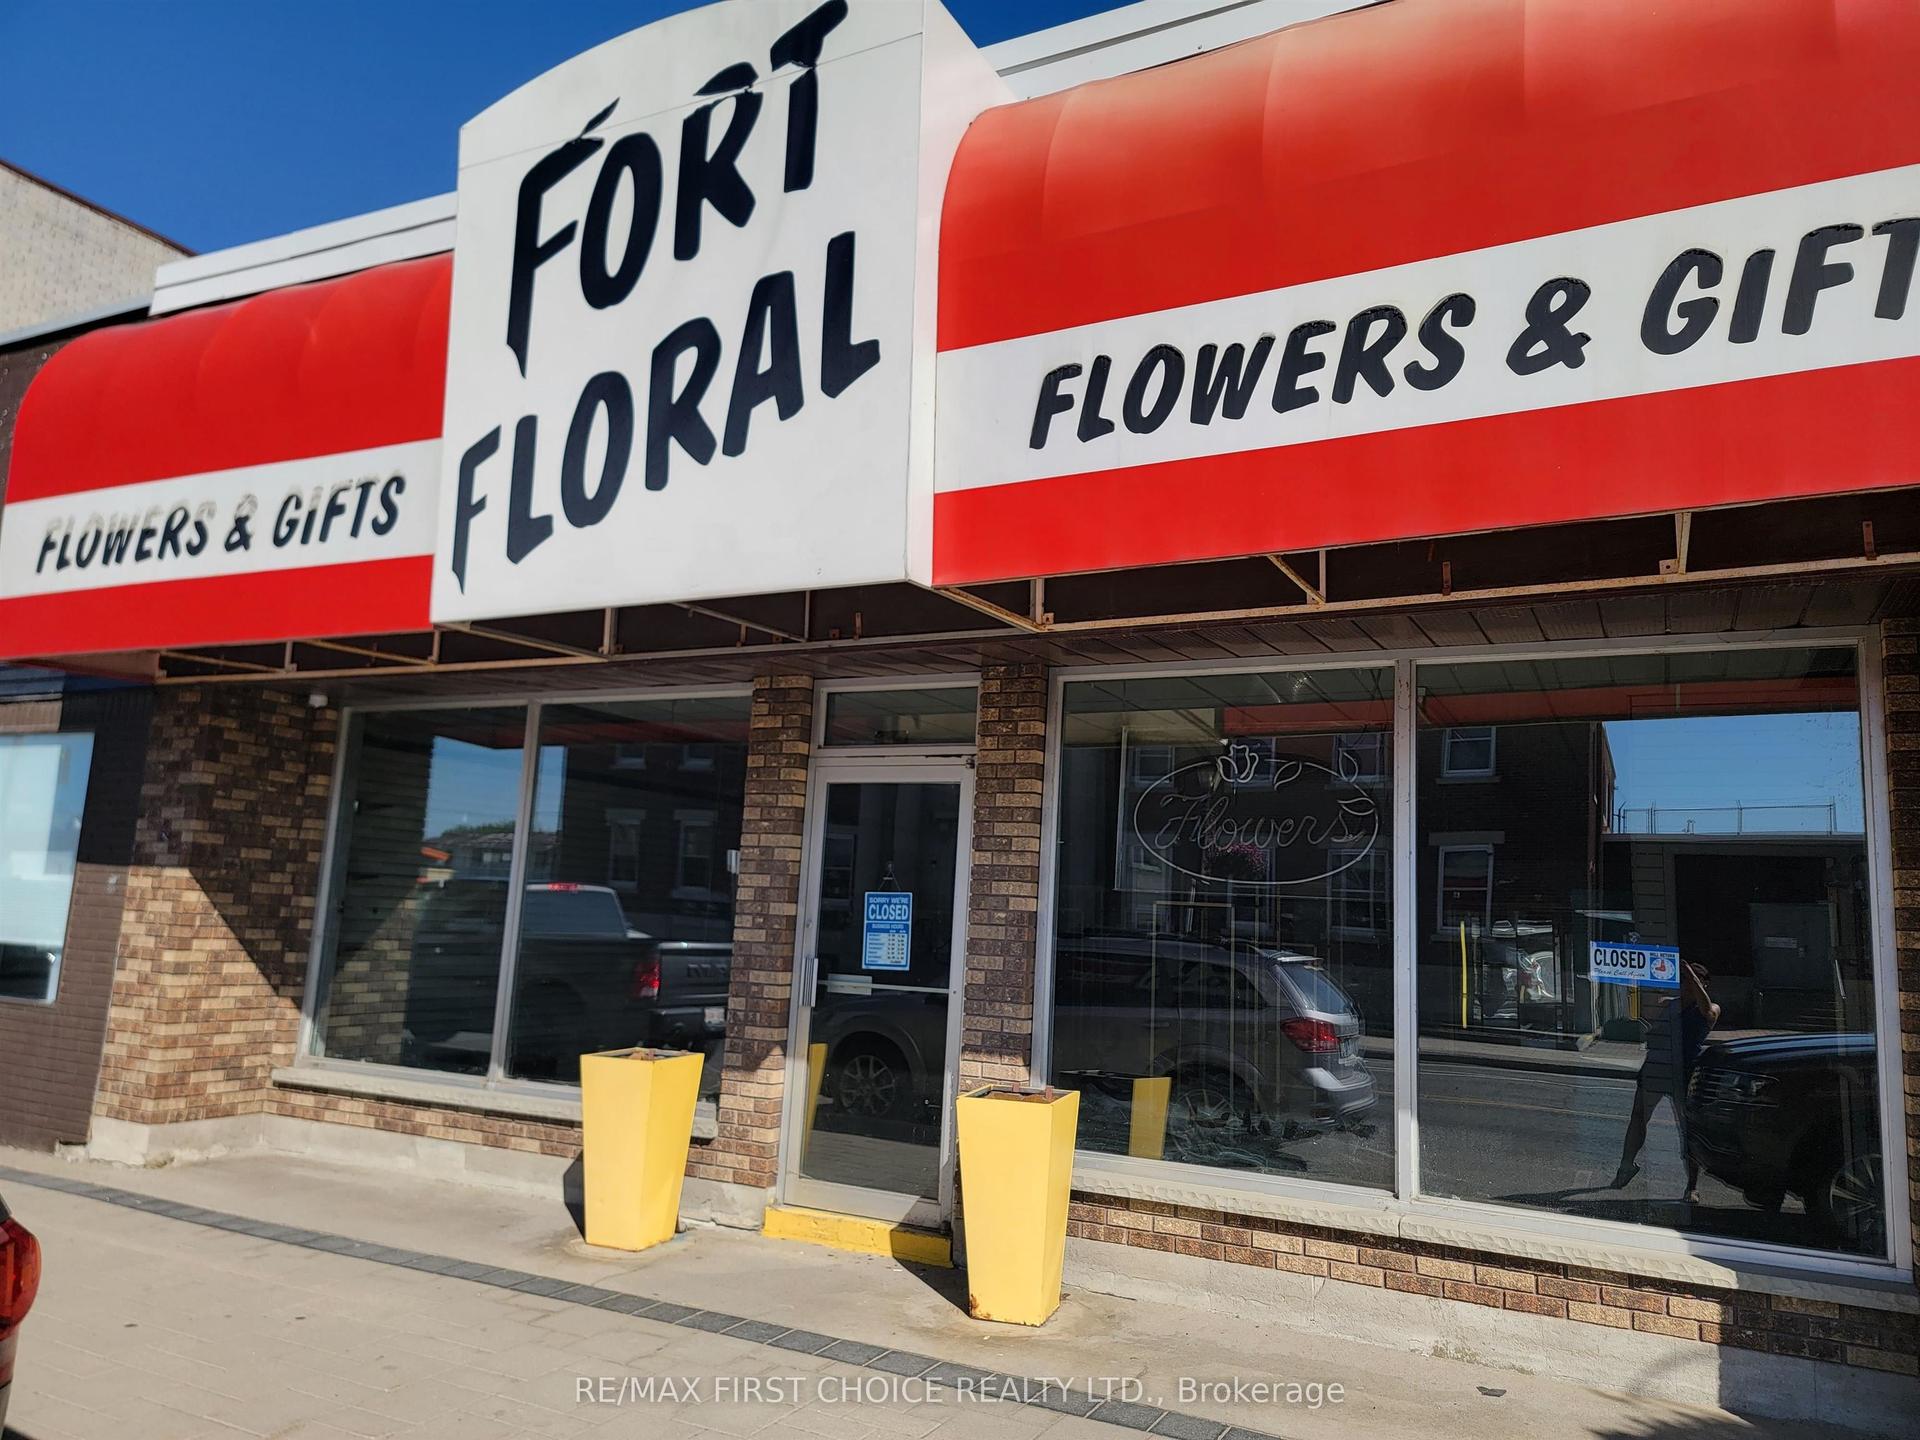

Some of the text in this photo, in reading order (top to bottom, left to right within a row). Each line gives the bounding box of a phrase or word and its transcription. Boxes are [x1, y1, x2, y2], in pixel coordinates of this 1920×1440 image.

[506, 0, 849, 378] FORT
[1028, 290, 1478, 451] FLOWERS
[1505, 275, 1593, 377] &
[451, 231, 880, 595] FLORAL
[35, 475, 407, 574] FLOWERS & GIFTS
[1154, 793, 1366, 854] Flowers
[868, 904, 909, 920] CLOSED
[1594, 949, 1646, 969] CLOSED
